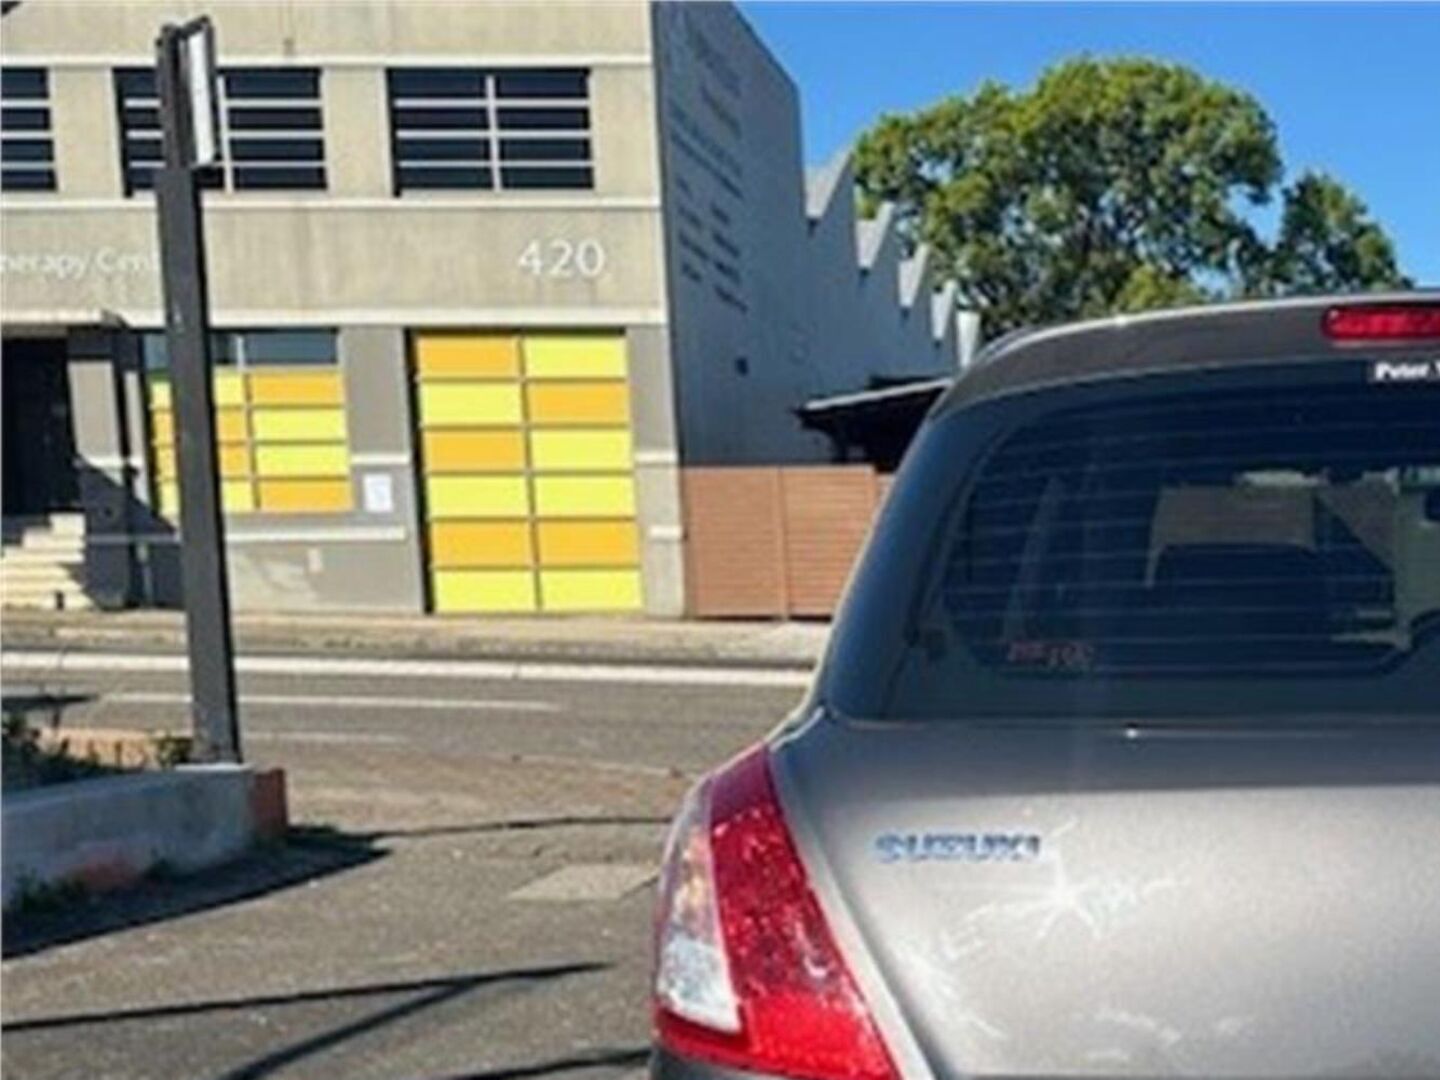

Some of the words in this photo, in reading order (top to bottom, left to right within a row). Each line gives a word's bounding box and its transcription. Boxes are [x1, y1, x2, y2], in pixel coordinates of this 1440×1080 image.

[519, 238, 606, 277] 420
[1374, 360, 1429, 381] Peter
[874, 833, 1041, 863] SUZUKI
